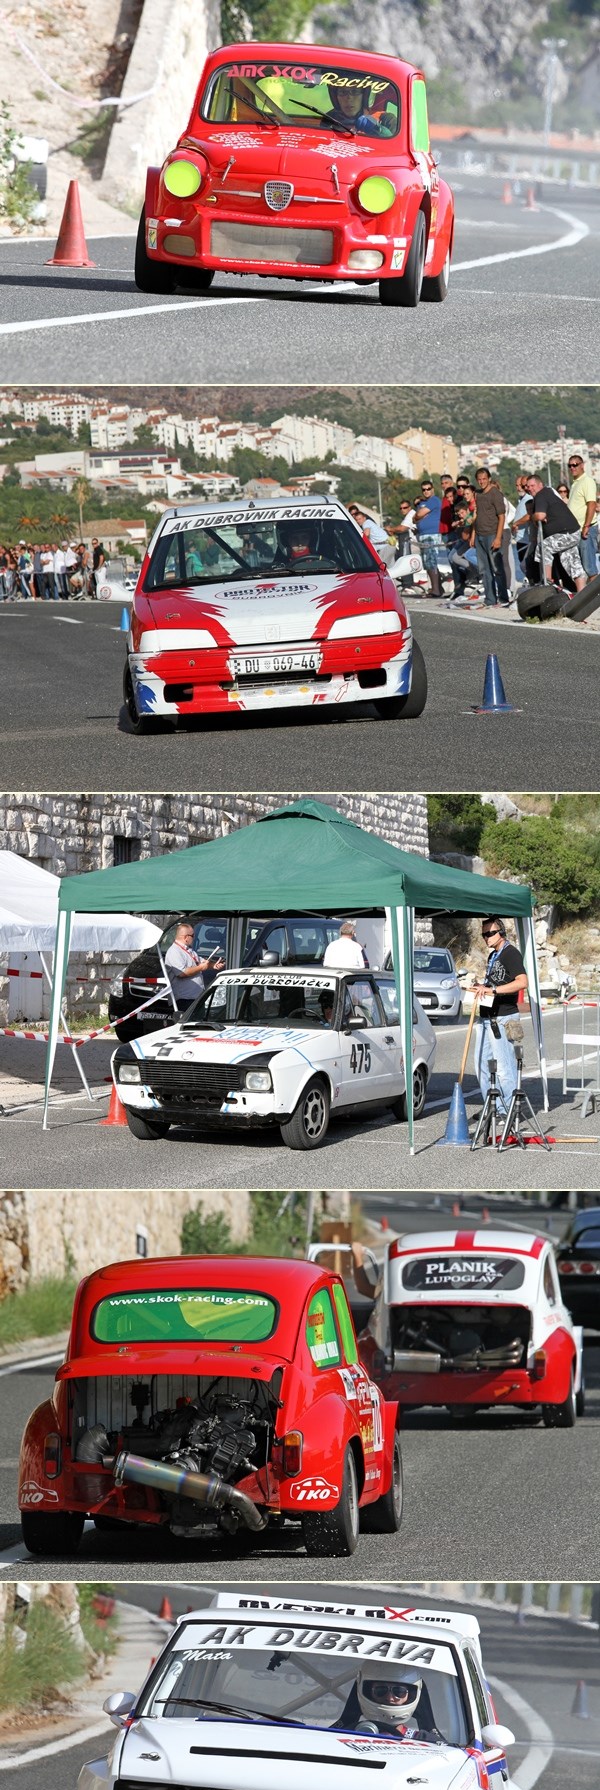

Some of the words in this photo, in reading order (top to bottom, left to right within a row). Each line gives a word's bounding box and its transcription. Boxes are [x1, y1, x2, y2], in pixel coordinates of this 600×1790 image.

[226, 65, 266, 78] AMK
[271, 66, 317, 80] SKOK
[319, 72, 390, 93] Racing
[169, 520, 196, 532] AK
[193, 510, 280, 528] DUBROVNIK
[280, 508, 336, 518] RACING
[245, 658, 260, 673] DU
[273, 654, 316, 671] 069-46
[350, 1043, 372, 1074] 475
[426, 1262, 496, 1274] PLANIK
[425, 1276, 496, 1284] LUPOGLAV
[109, 1295, 268, 1306] www.skok-racing.com
[21, 1492, 44, 1503] IKO
[296, 1488, 330, 1500] IKO
[199, 1626, 256, 1645] AK
[265, 1628, 436, 1664] DUBRAVA
[182, 1650, 233, 1660] Mata
